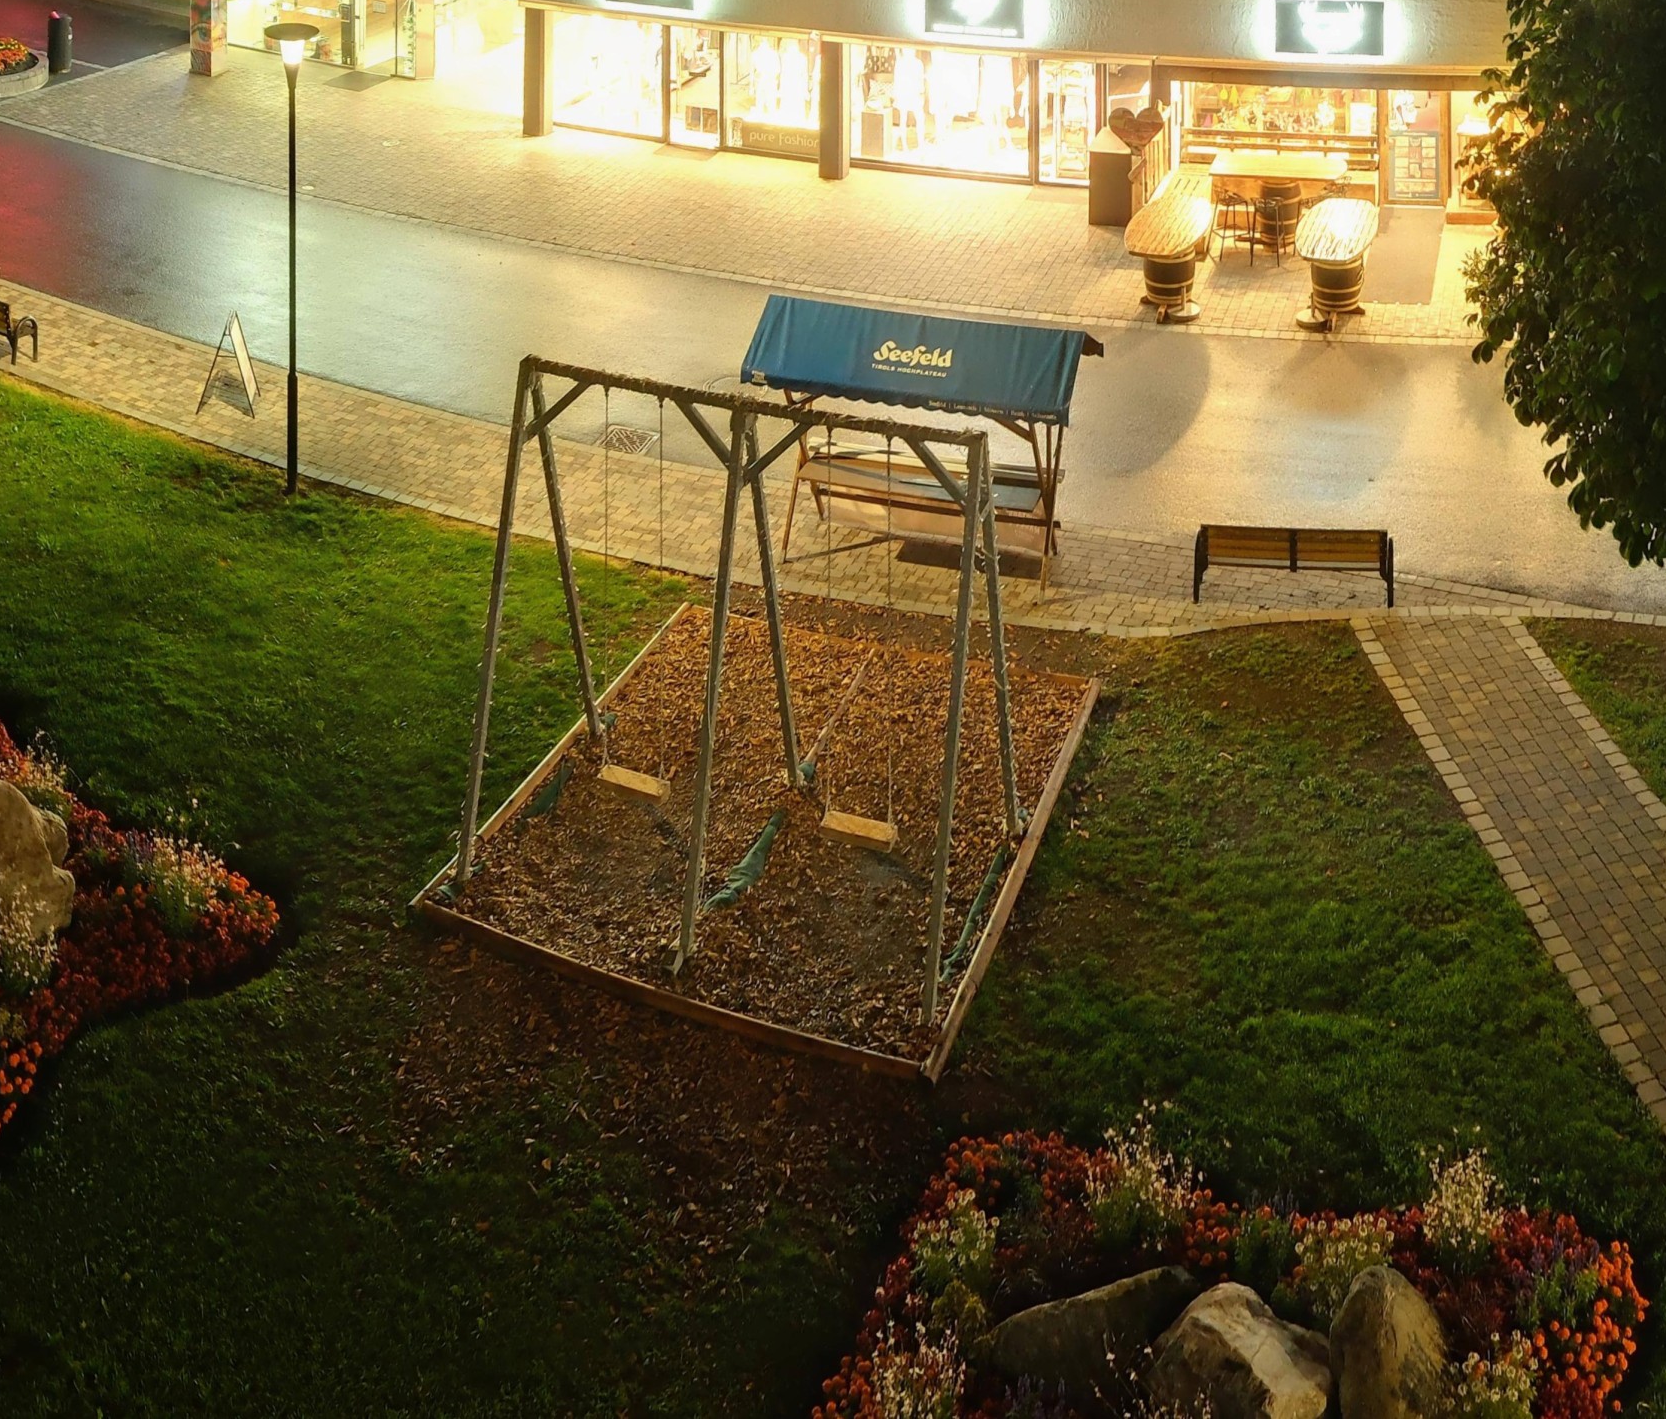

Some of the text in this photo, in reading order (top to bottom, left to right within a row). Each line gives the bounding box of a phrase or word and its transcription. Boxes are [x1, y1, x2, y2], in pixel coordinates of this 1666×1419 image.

[749, 132, 775, 142] pure
[872, 340, 953, 368] Seefeld
[872, 363, 947, 378] TIROLS HOCHPLATEAU
